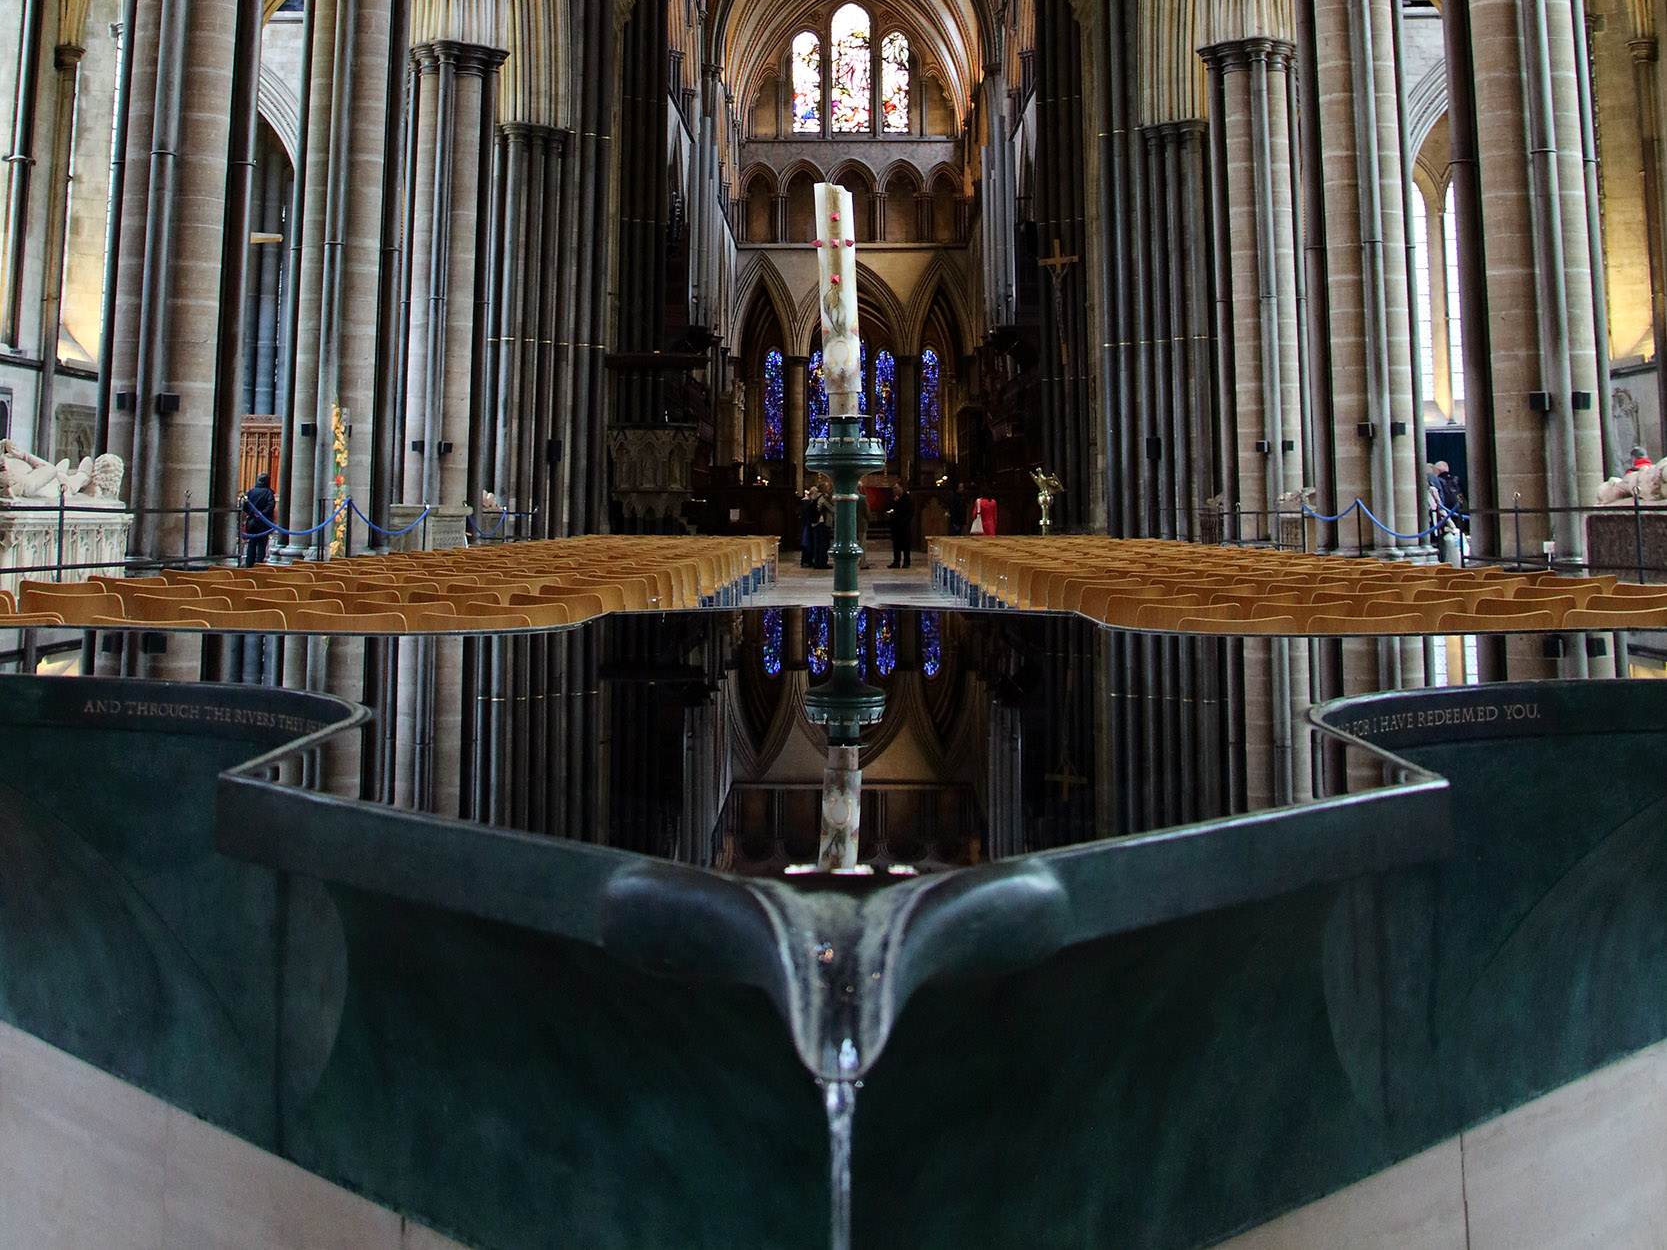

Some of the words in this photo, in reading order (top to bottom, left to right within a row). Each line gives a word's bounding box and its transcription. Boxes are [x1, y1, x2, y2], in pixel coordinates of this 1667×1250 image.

[84, 699, 121, 713] AND
[124, 701, 199, 719] THROUGH
[205, 706, 230, 723] THE
[234, 708, 276, 727] RIVERS
[1380, 712, 1414, 732] HAVE
[1418, 706, 1498, 727] REDEEMED
